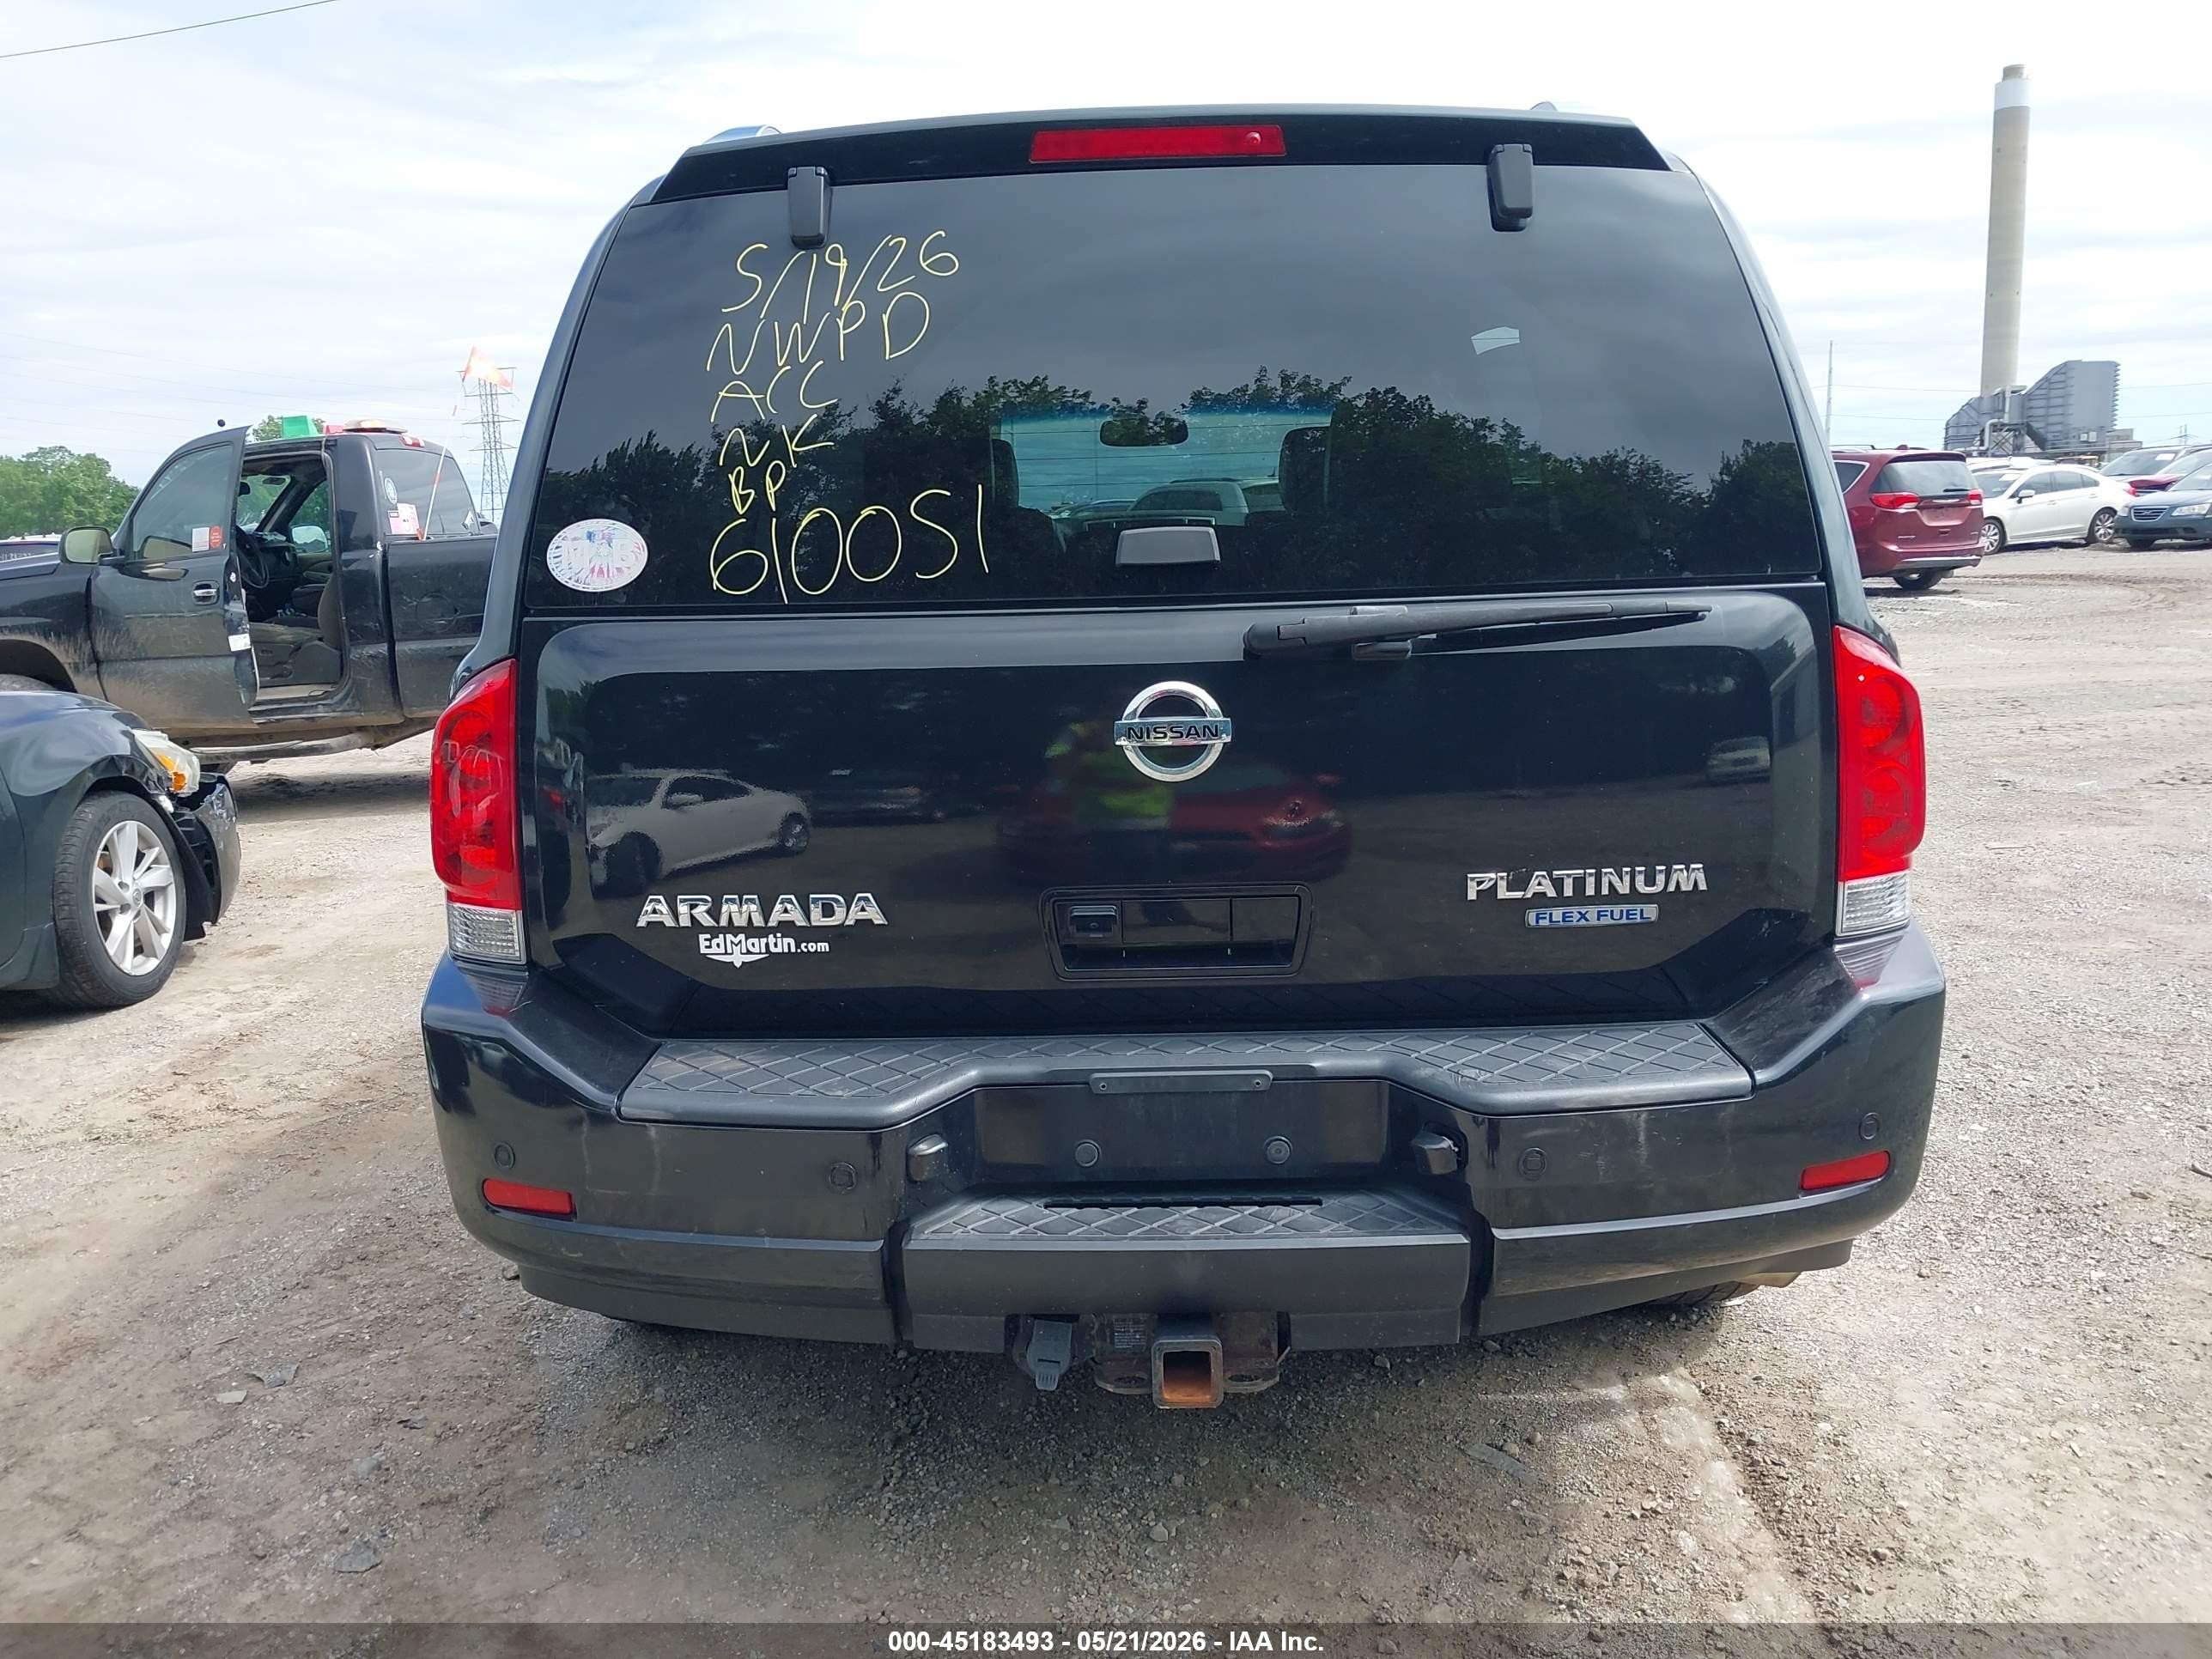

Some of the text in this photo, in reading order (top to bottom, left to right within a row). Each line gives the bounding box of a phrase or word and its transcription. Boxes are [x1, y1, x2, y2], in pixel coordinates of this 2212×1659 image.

[711, 360, 839, 422] ACC
[1127, 725, 1219, 740] NISSAN
[1467, 864, 1708, 901] PLATINUM
[636, 892, 888, 927] ARMADA
[1534, 908, 1651, 925] FLEX FUEL
